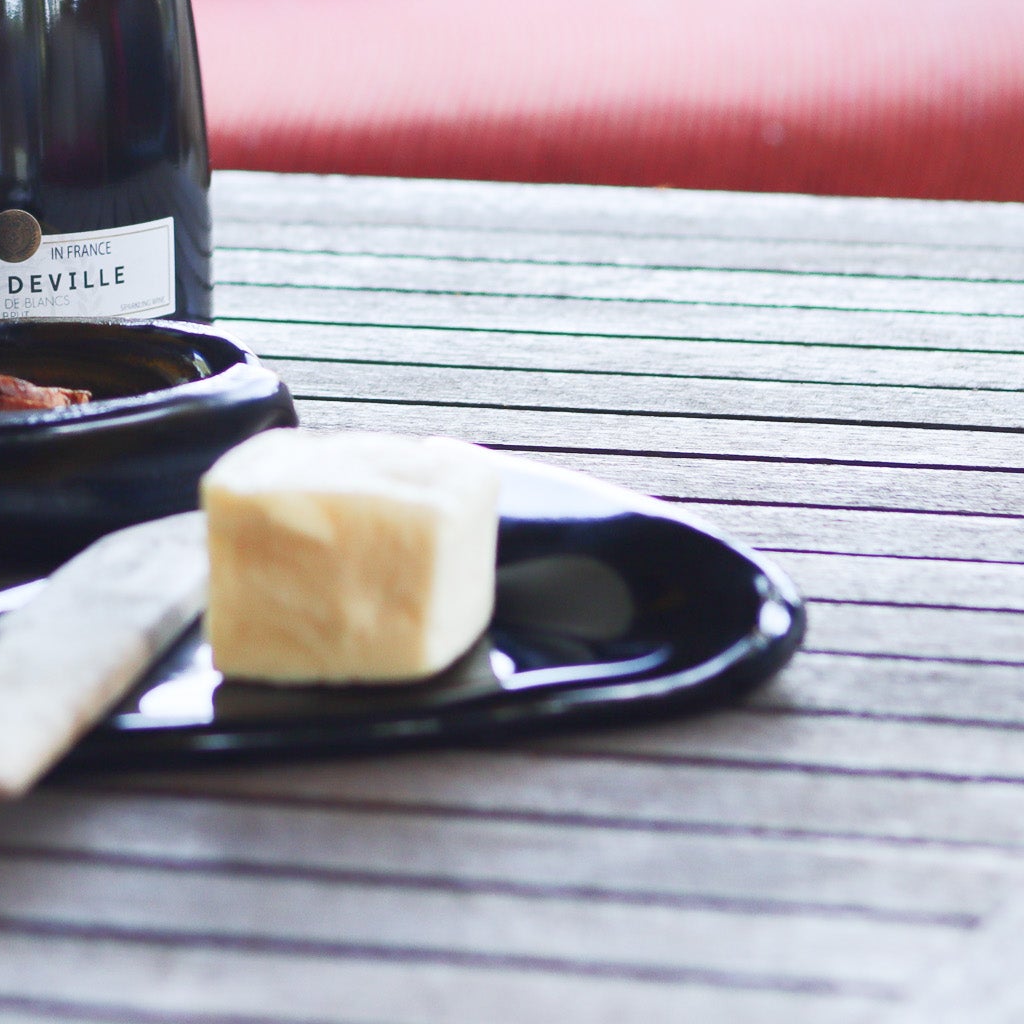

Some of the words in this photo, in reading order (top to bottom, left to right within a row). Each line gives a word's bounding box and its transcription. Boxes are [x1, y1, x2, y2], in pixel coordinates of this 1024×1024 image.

[51, 246, 64, 261] IN
[67, 241, 112, 259] FRANCE
[8, 265, 125, 294] DEVILLE
[4, 298, 20, 310] DE
[24, 294, 71, 309] BLANCS
